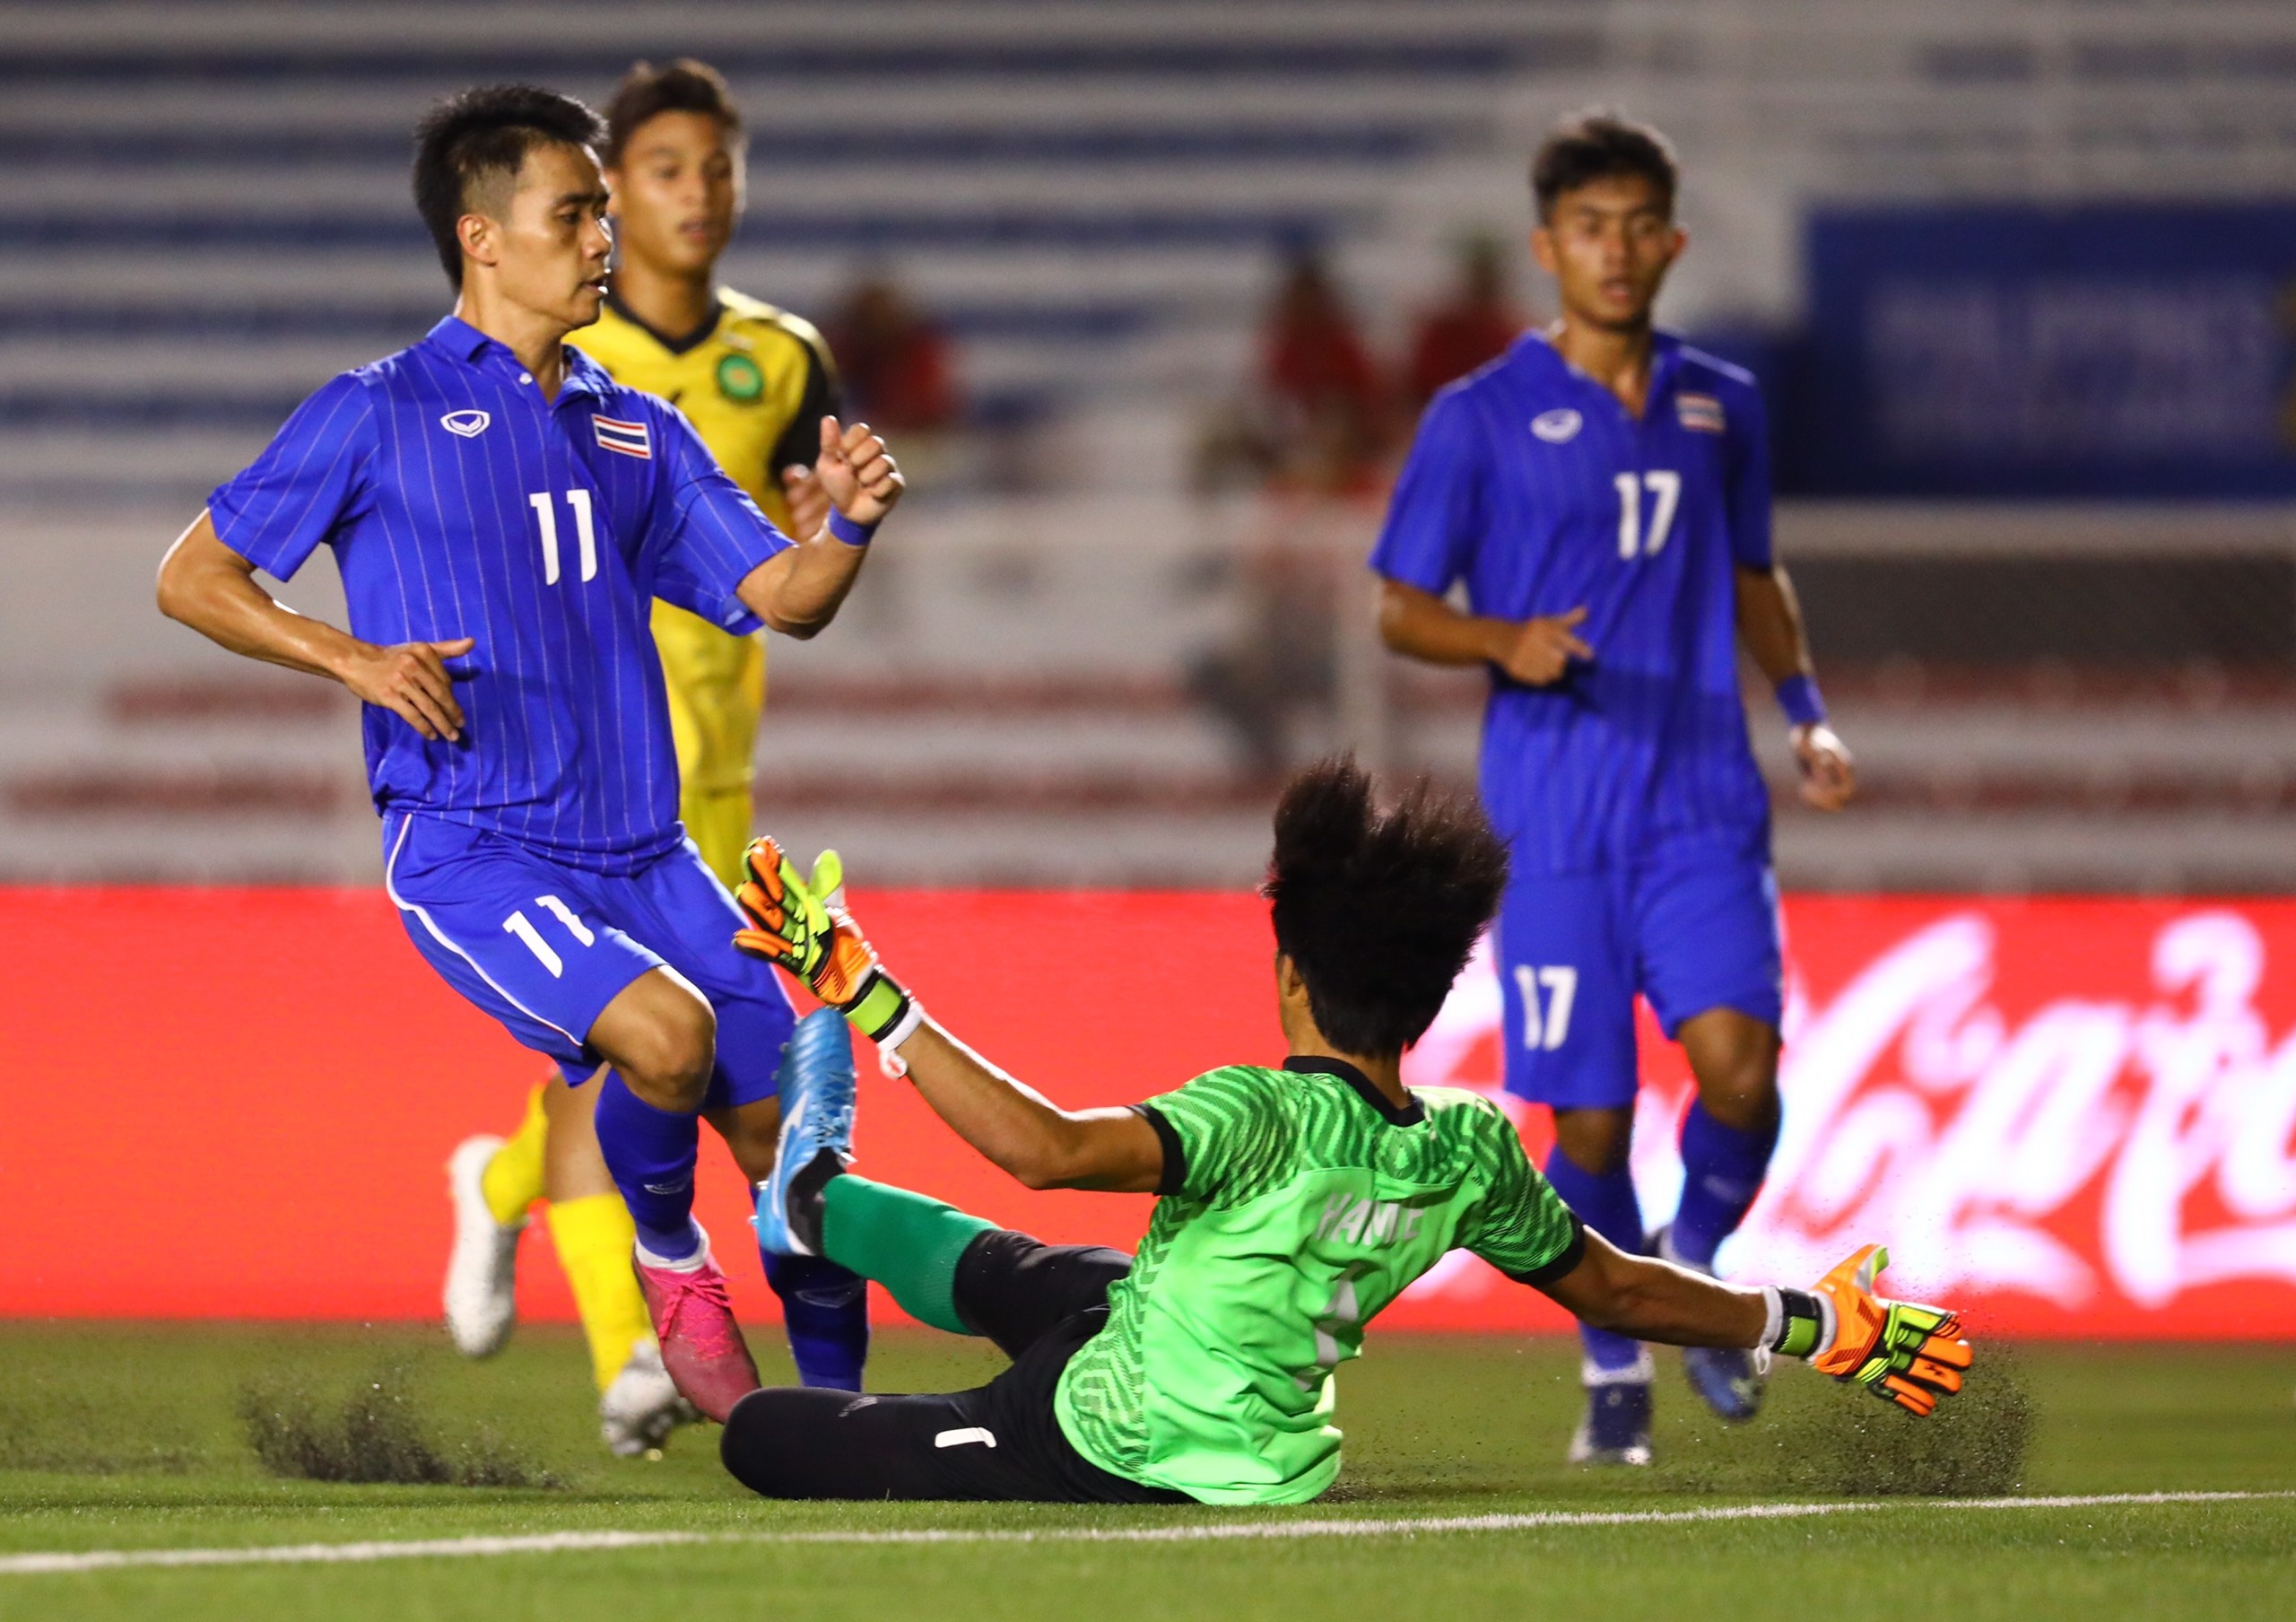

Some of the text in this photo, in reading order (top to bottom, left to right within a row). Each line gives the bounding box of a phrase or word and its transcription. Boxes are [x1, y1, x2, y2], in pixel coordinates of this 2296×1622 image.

[529, 489, 597, 586] 11
[1614, 469, 1681, 561] 17
[502, 894, 596, 979] 11
[1514, 964, 1578, 1051] 17
